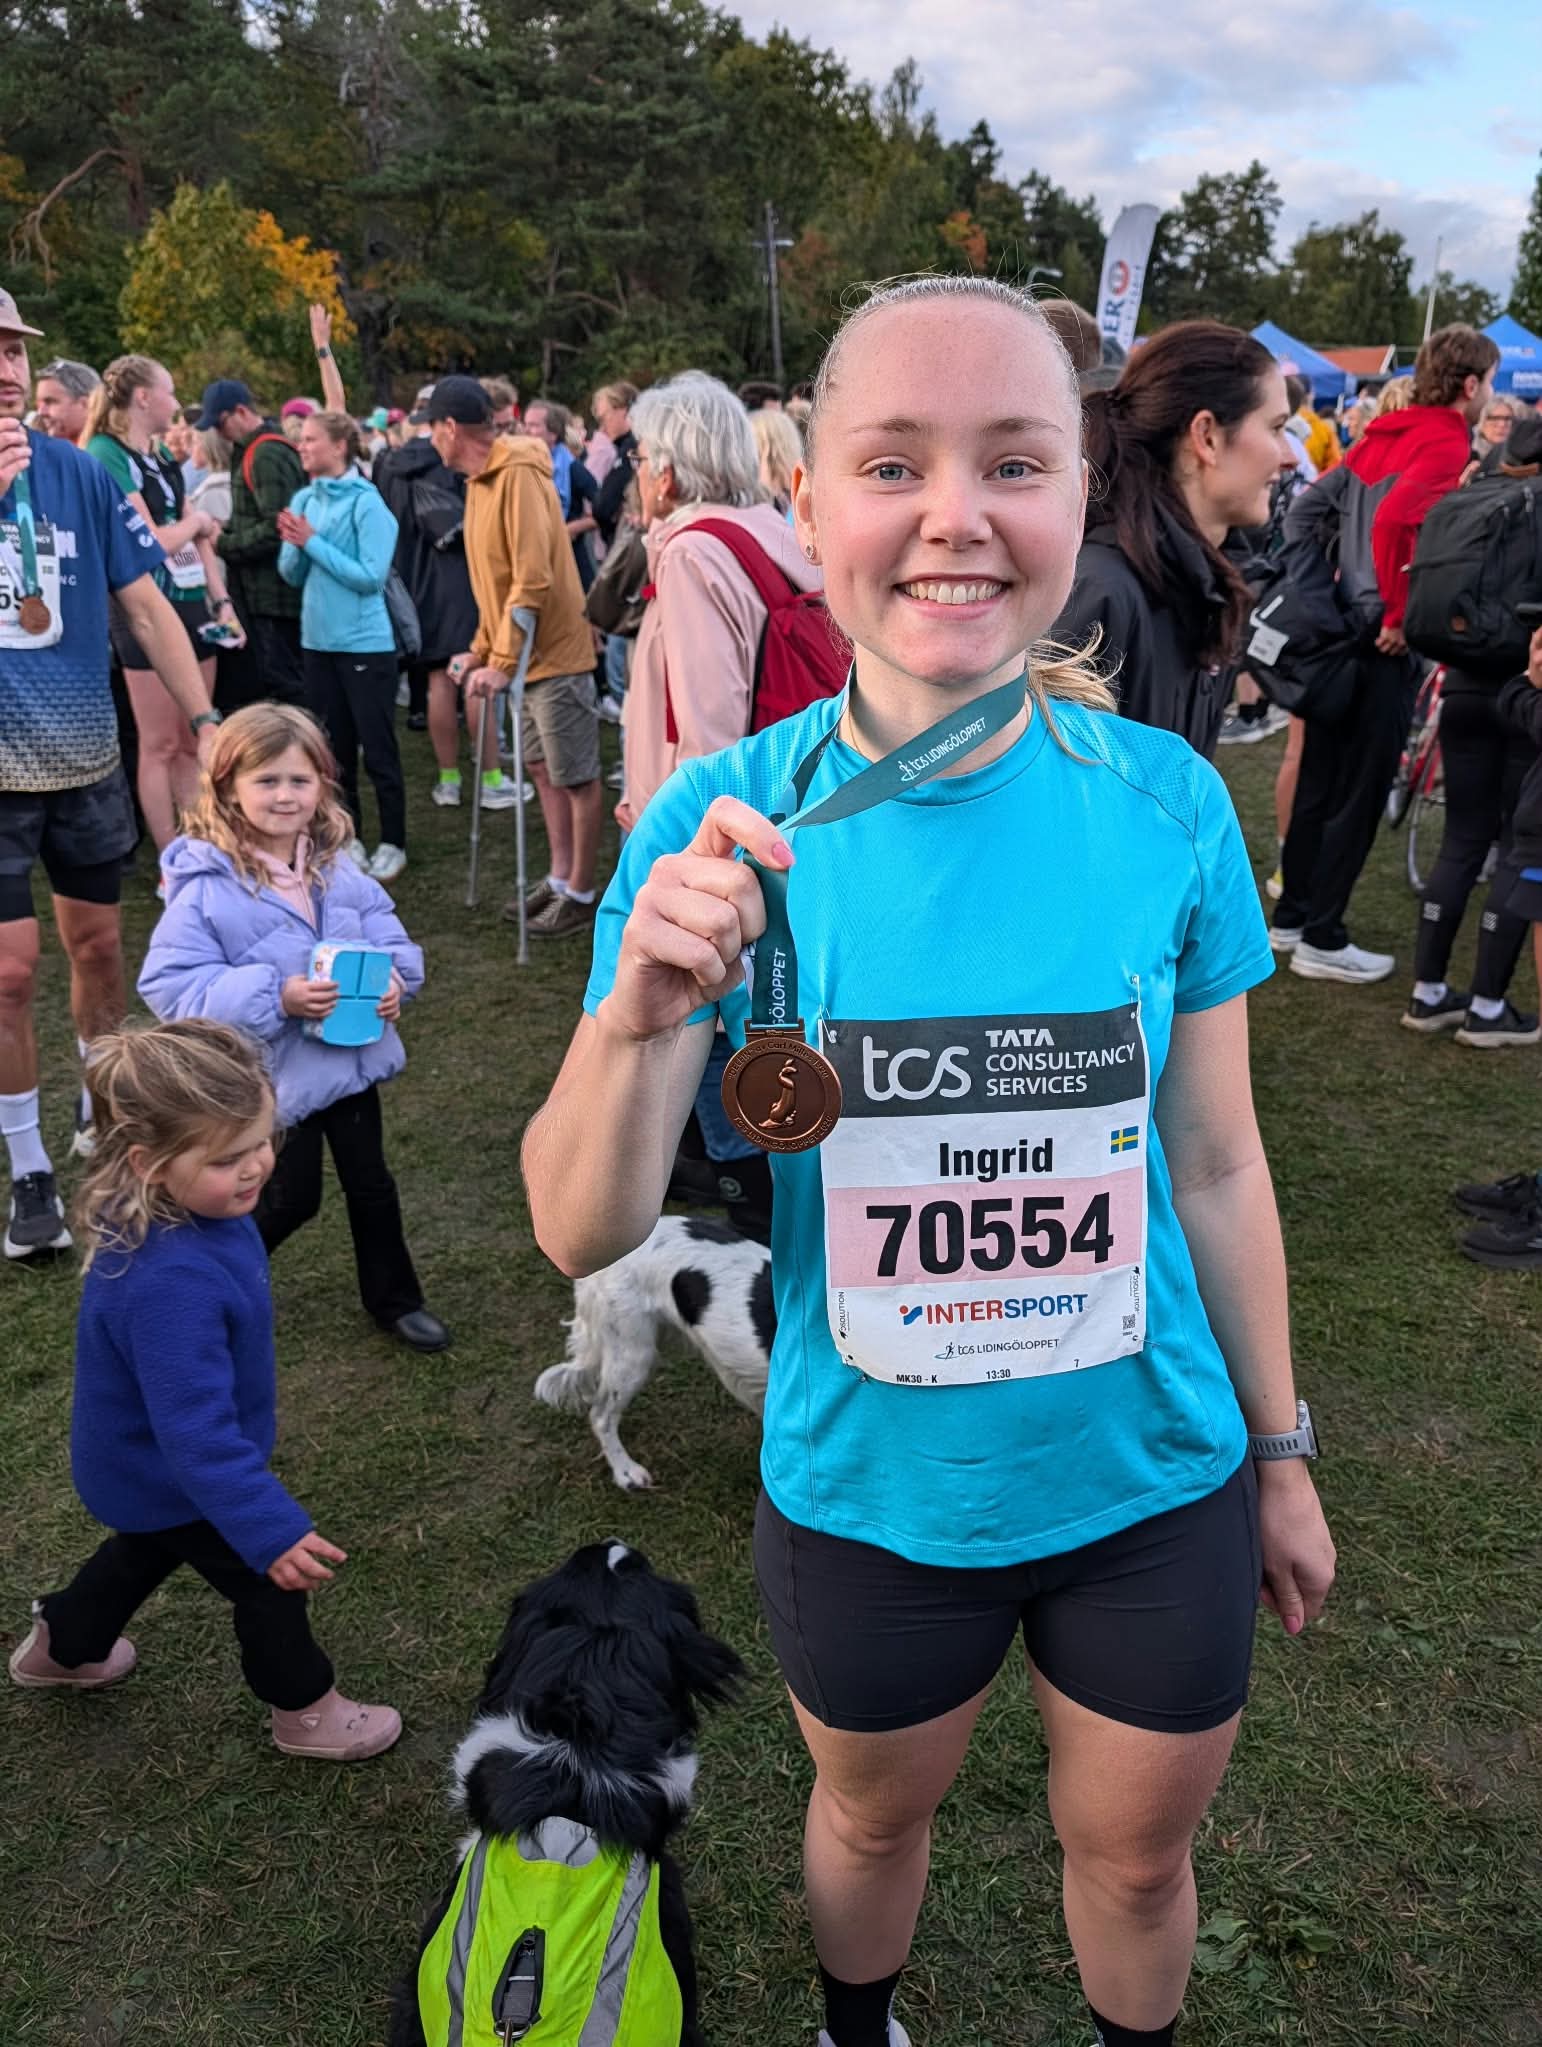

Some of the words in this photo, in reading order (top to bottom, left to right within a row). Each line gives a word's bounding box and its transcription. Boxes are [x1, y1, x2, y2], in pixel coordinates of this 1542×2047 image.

[909, 756, 929, 770] tcs
[924, 717, 986, 763] LIDINGÖLOPPET
[986, 1028, 1055, 1048] TATA
[863, 1035, 972, 1101] tcs
[986, 1042, 1136, 1072] CONSULTANCY
[986, 1075, 1088, 1097] SERVICES
[939, 1137, 1053, 1183] Ingrid
[866, 1191, 1114, 1277] 70554
[927, 1293, 1089, 1325] INTERSPORT
[957, 1344, 975, 1356] tcs
[977, 1338, 1060, 1354] LIDINGÖLOPPET
[986, 1368, 1011, 1380] 13:30
[1073, 1358, 1080, 1368] 7
[896, 1374, 922, 1384] MK30
[931, 1374, 938, 1384] K
